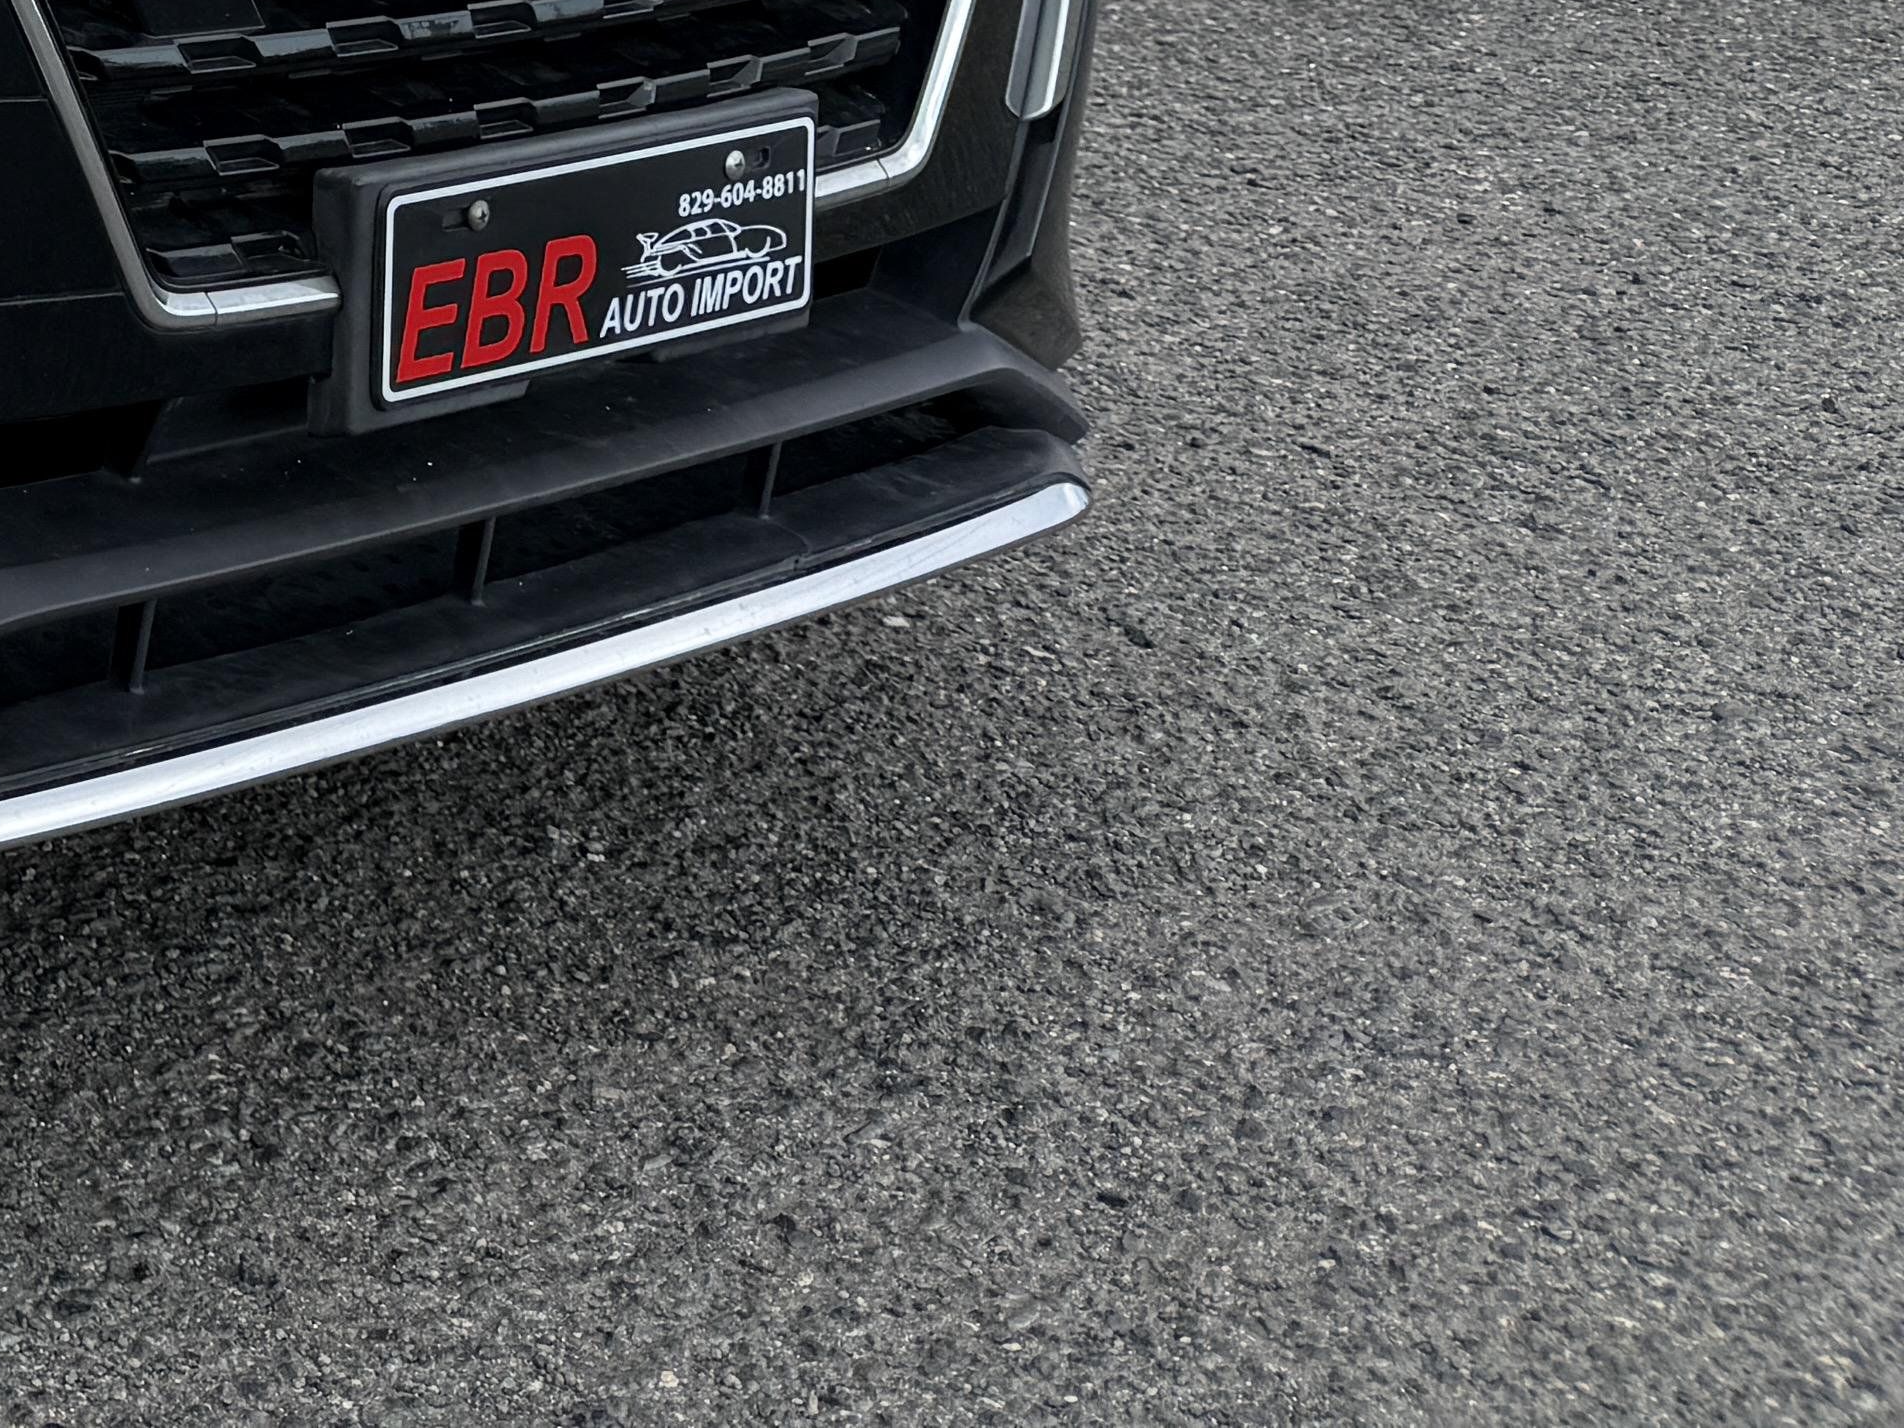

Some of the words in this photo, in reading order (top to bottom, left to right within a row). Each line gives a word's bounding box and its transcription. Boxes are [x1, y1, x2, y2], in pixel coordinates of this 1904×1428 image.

[678, 169, 806, 218] 829-604-8811
[395, 234, 597, 384] EBR
[599, 282, 685, 339] AUTO
[690, 256, 802, 317] IMPORT
